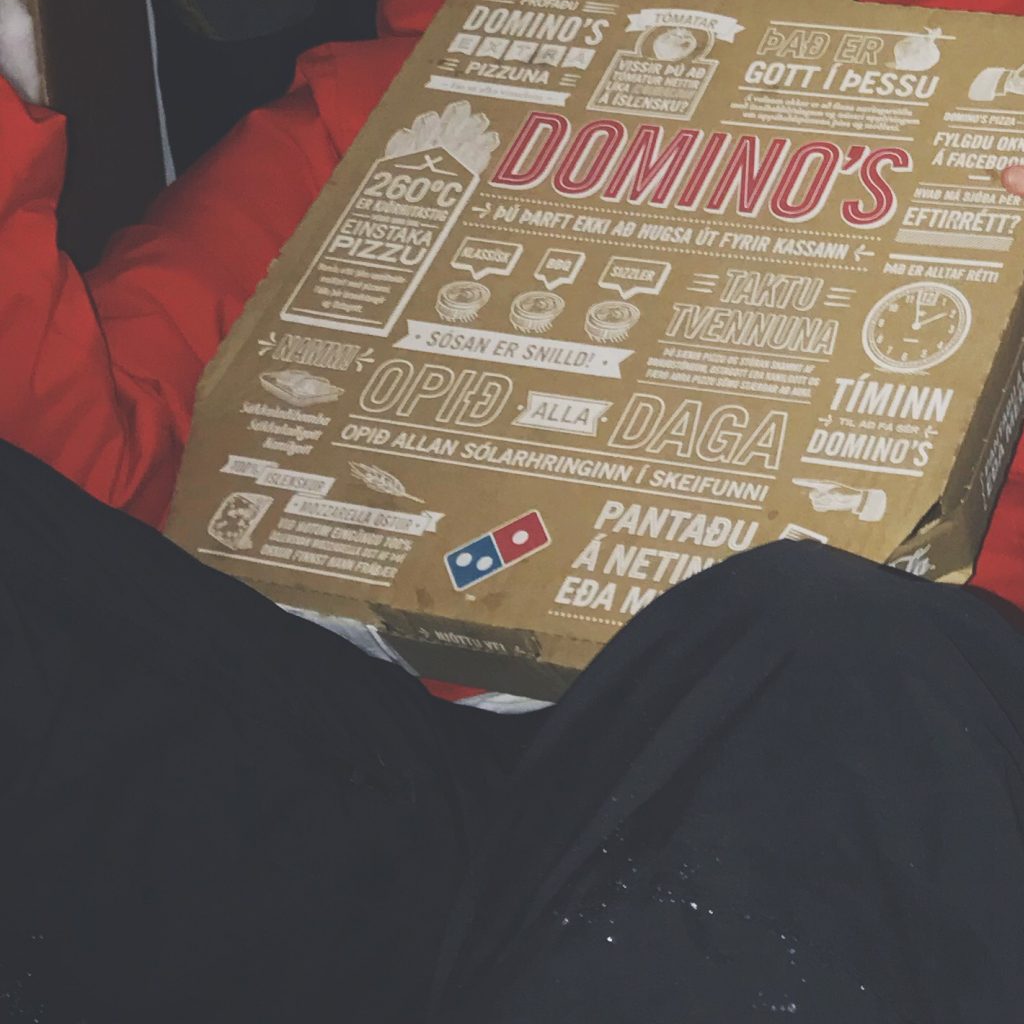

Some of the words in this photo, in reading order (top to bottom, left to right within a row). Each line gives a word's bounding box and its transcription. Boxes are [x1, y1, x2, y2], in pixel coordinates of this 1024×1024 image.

[464, 5, 608, 44] DOMINO'S
[655, 11, 718, 28] TÓMATAR
[756, 26, 830, 60] ÞAÐ
[833, 33, 884, 65] ER
[465, 61, 549, 84] PIZZUNA
[744, 60, 820, 87] GOTT
[822, 63, 841, 90] Í
[840, 69, 938, 98] ÞESSU
[931, 147, 946, 165] Á
[933, 131, 994, 150] FYLGDU
[498, 114, 908, 226] DOMINO'S
[340, 219, 432, 246] EINSTAKA
[492, 203, 520, 222] ÞÚ
[518, 208, 573, 229] ÞARFT
[572, 214, 611, 234] EKKI
[610, 220, 636, 237] AÐ
[637, 223, 692, 243] HUGSA
[694, 226, 719, 246] ÚT
[718, 231, 771, 252] FYRIR
[772, 237, 849, 259] KASSANN
[902, 200, 1020, 233] EFTIRRÉTT?
[329, 235, 426, 265] PIZZU
[720, 269, 823, 311] TAKTU
[906, 264, 924, 276] ER
[924, 265, 965, 279] ALLTAF
[668, 303, 838, 354] TVENNUNA
[426, 330, 490, 353] SÓSAN
[492, 340, 519, 358] ER
[521, 344, 594, 367] SNILLD!
[360, 358, 512, 426] OPIÐ
[831, 373, 952, 421] TÍMINN
[530, 401, 589, 425] ALLA
[609, 393, 787, 469] DAGA
[340, 423, 390, 444] OPIÐ
[391, 432, 458, 455] ALLAN
[461, 442, 631, 481] SÓLARHRINGINN
[634, 463, 650, 484] Í
[650, 470, 768, 501] SKEIFUNNI
[807, 429, 932, 466] DOMINO'S
[595, 501, 757, 550] PANTAÐU
[571, 532, 606, 571] Á
[555, 576, 616, 610] EÐA
[620, 585, 661, 615] M
